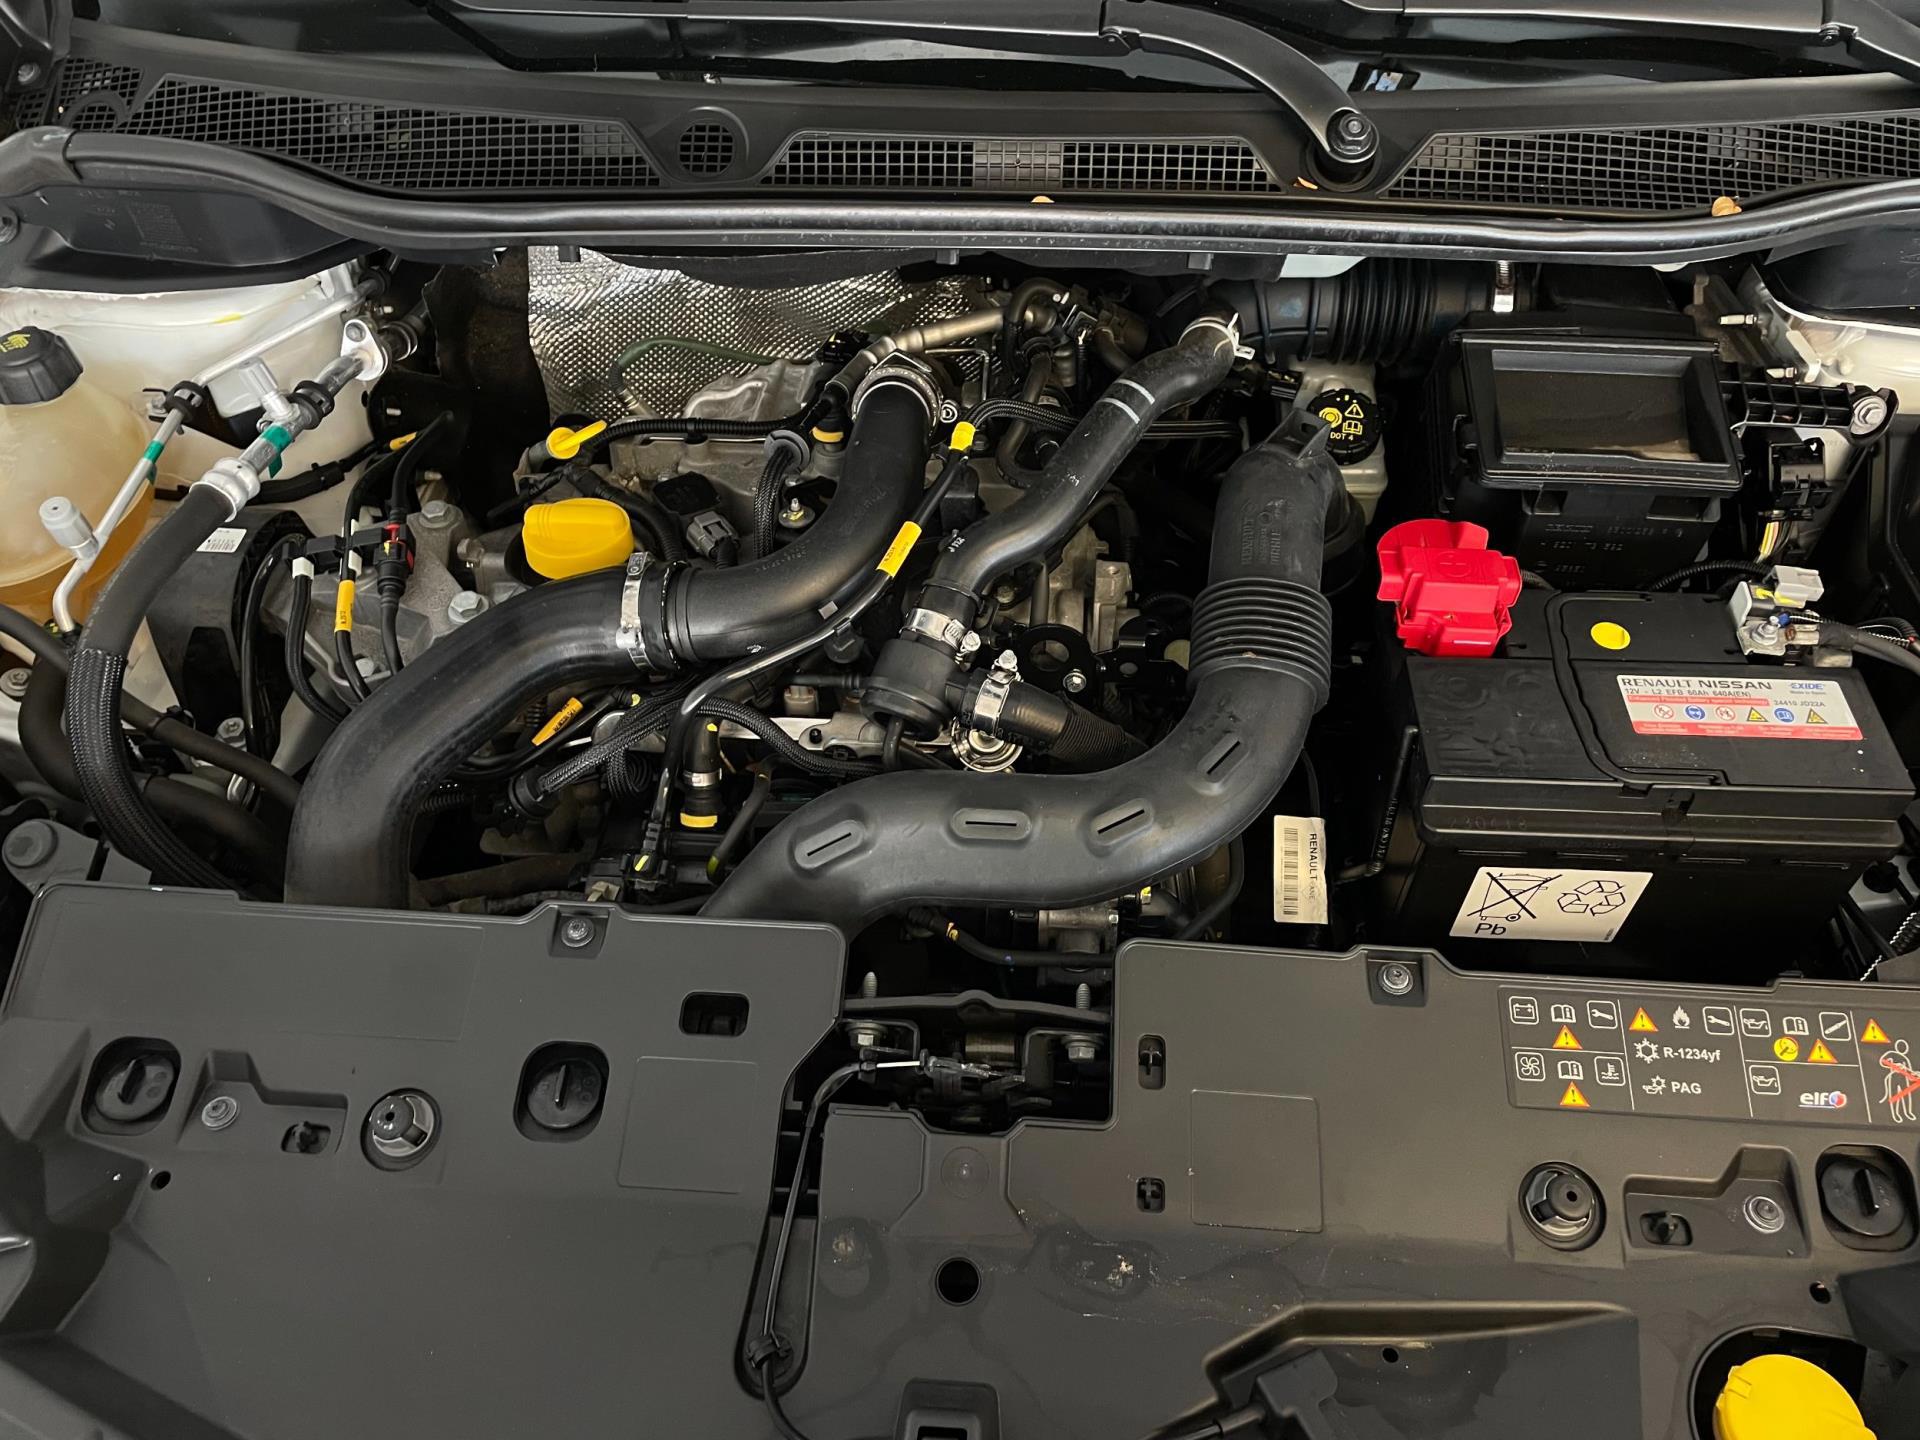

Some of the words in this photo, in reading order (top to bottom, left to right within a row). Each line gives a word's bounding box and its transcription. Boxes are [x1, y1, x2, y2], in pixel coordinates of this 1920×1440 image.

[1330, 431, 1347, 440] DOT
[1621, 678, 1692, 688] RENAULT
[1699, 680, 1773, 690] NISSAN
[1790, 682, 1825, 690] EXIDE
[1309, 833, 1318, 881] RENAULT
[1474, 922, 1507, 936] Pb
[1663, 1047, 1721, 1063] R-1234yf
[1671, 1081, 1702, 1095] PAG
[1799, 1092, 1830, 1106] elf
